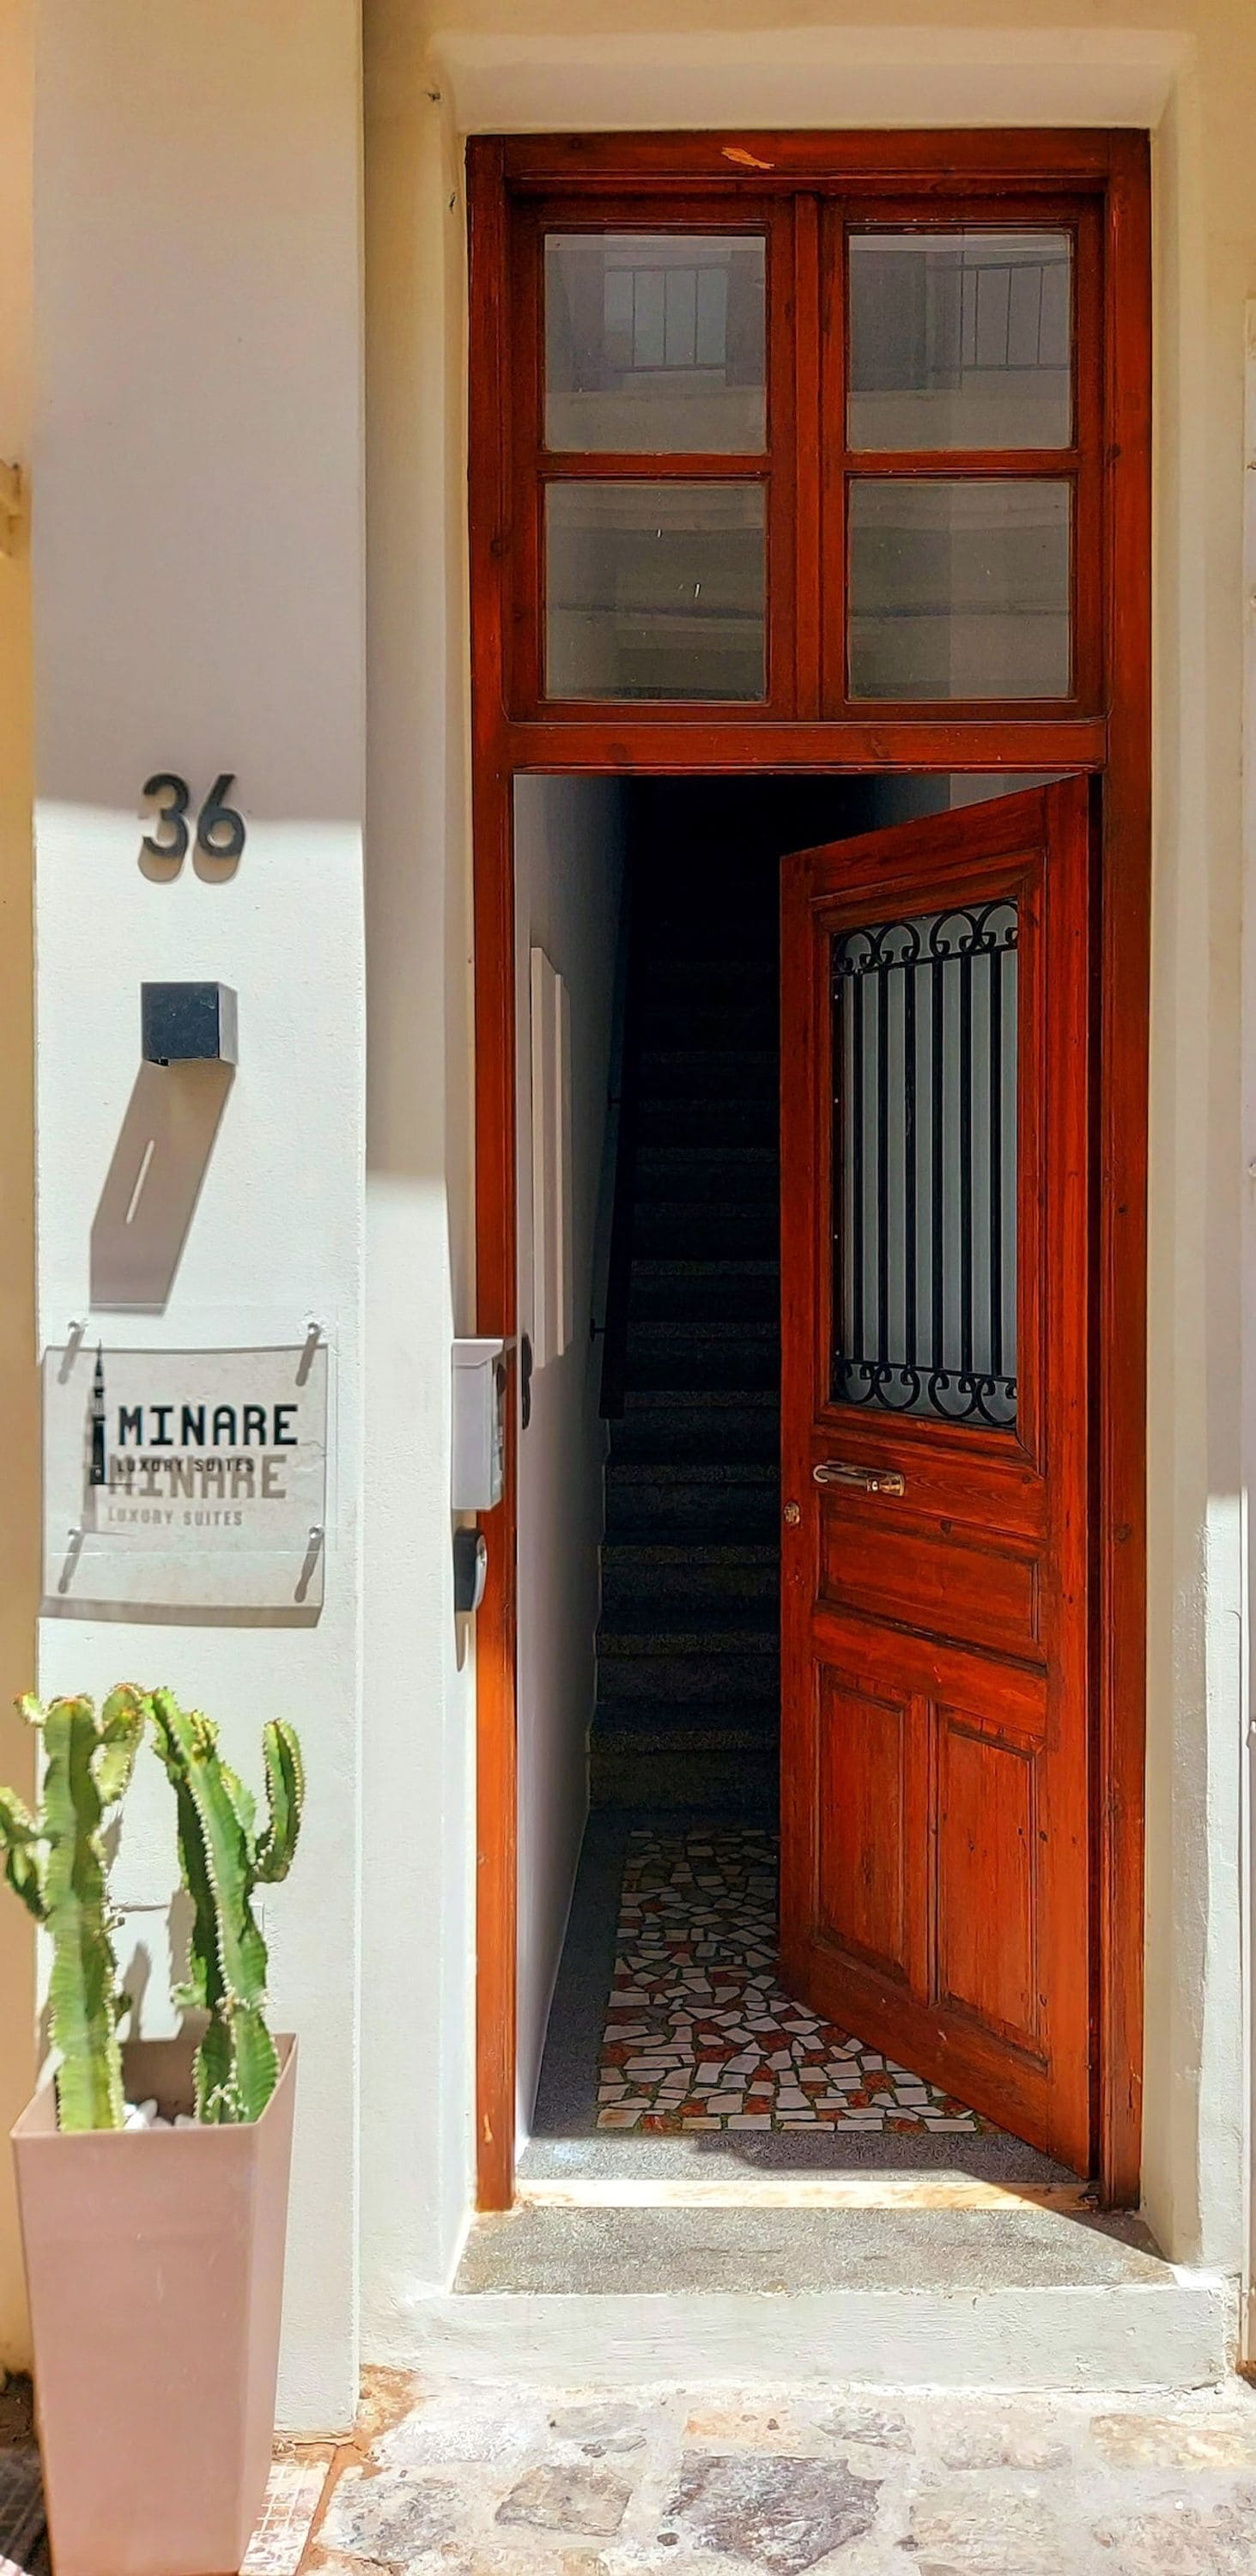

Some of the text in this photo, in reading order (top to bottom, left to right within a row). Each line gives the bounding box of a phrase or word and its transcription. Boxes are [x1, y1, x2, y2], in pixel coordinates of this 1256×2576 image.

[143, 774, 246, 857] 36
[118, 1404, 298, 1446] MINARE
[117, 1459, 255, 1473] LUXURY SUITES
